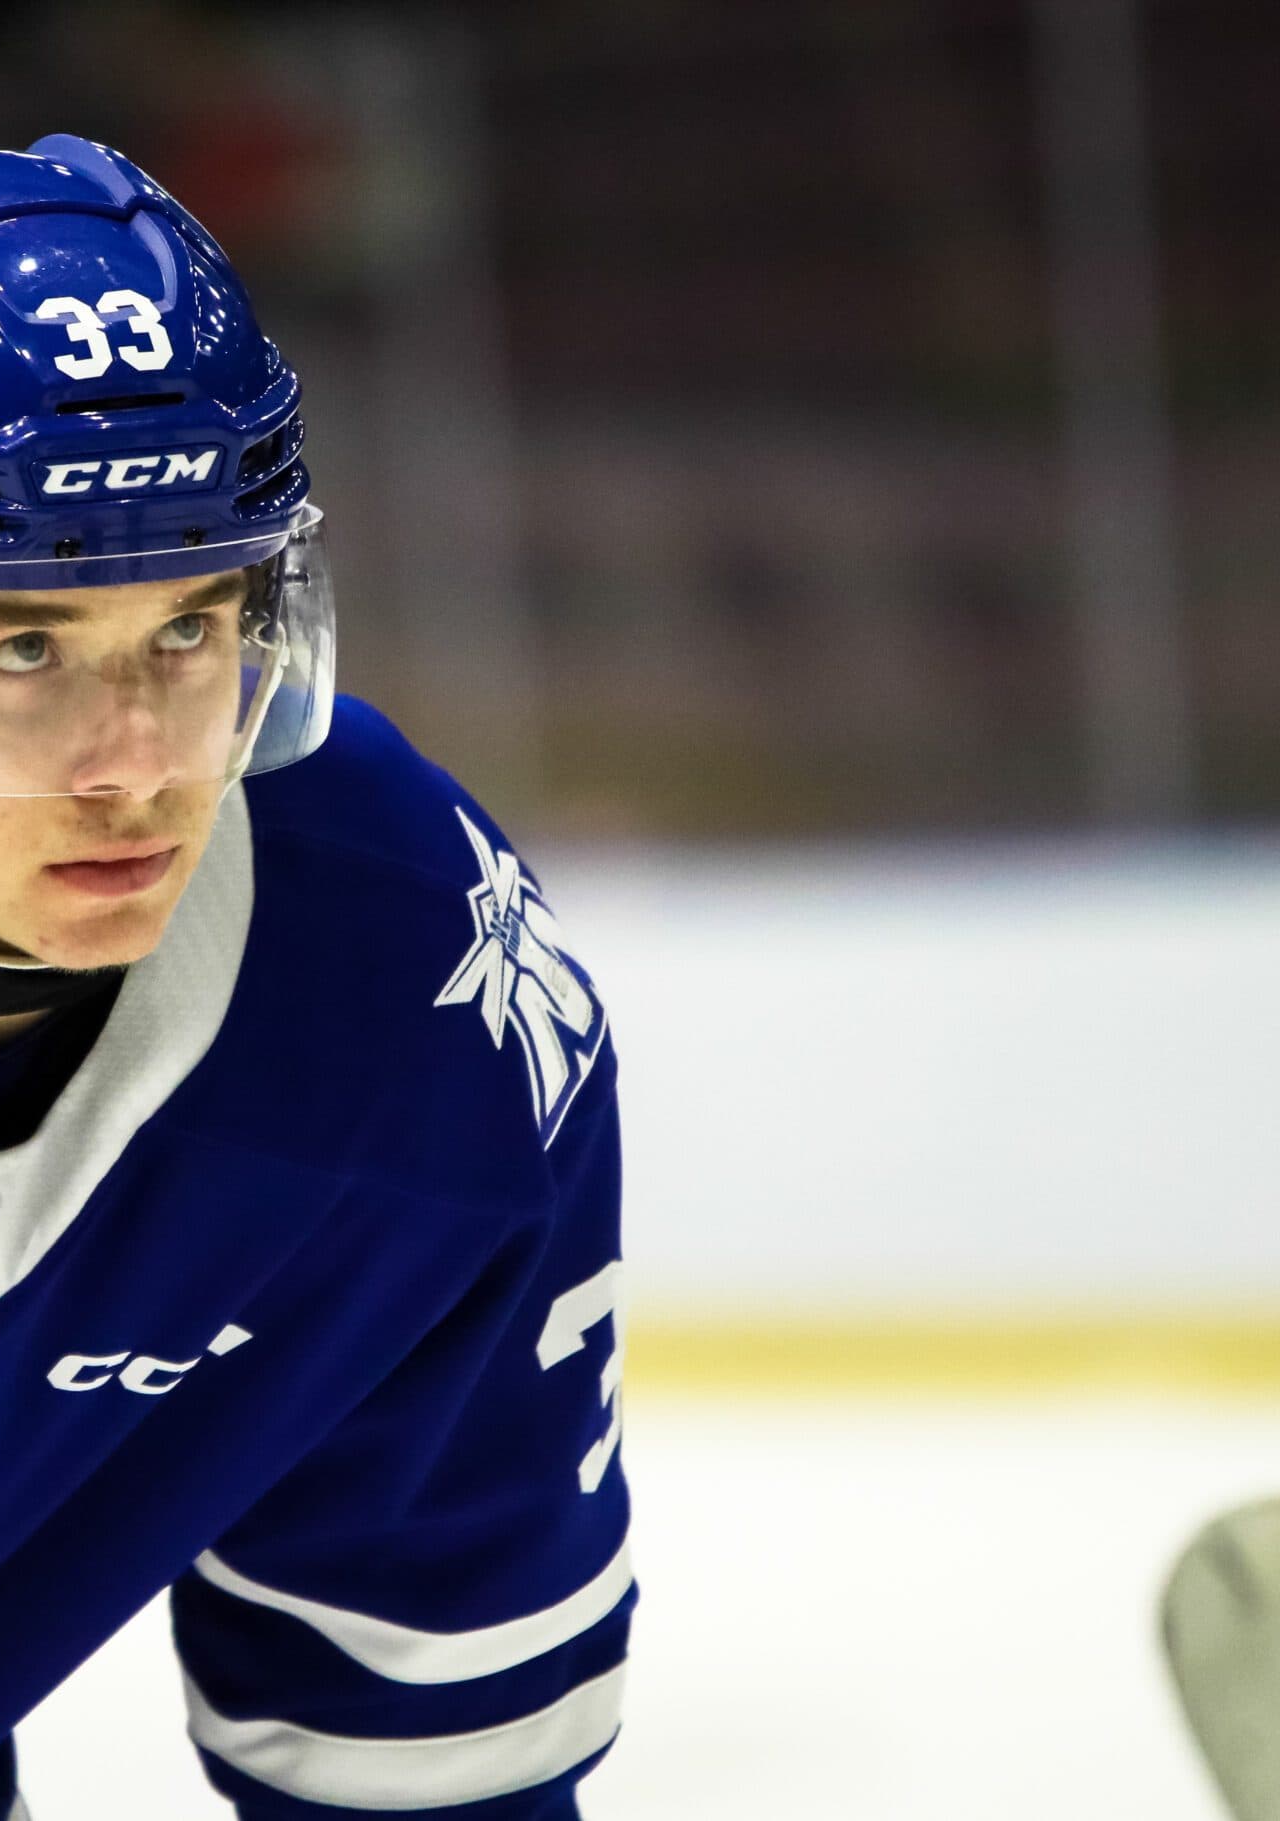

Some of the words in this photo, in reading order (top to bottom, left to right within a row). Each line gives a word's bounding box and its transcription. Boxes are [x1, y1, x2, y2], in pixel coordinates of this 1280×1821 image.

[35, 289, 174, 380] 33
[42, 450, 218, 494] CCM
[46, 1324, 254, 1395] CC
